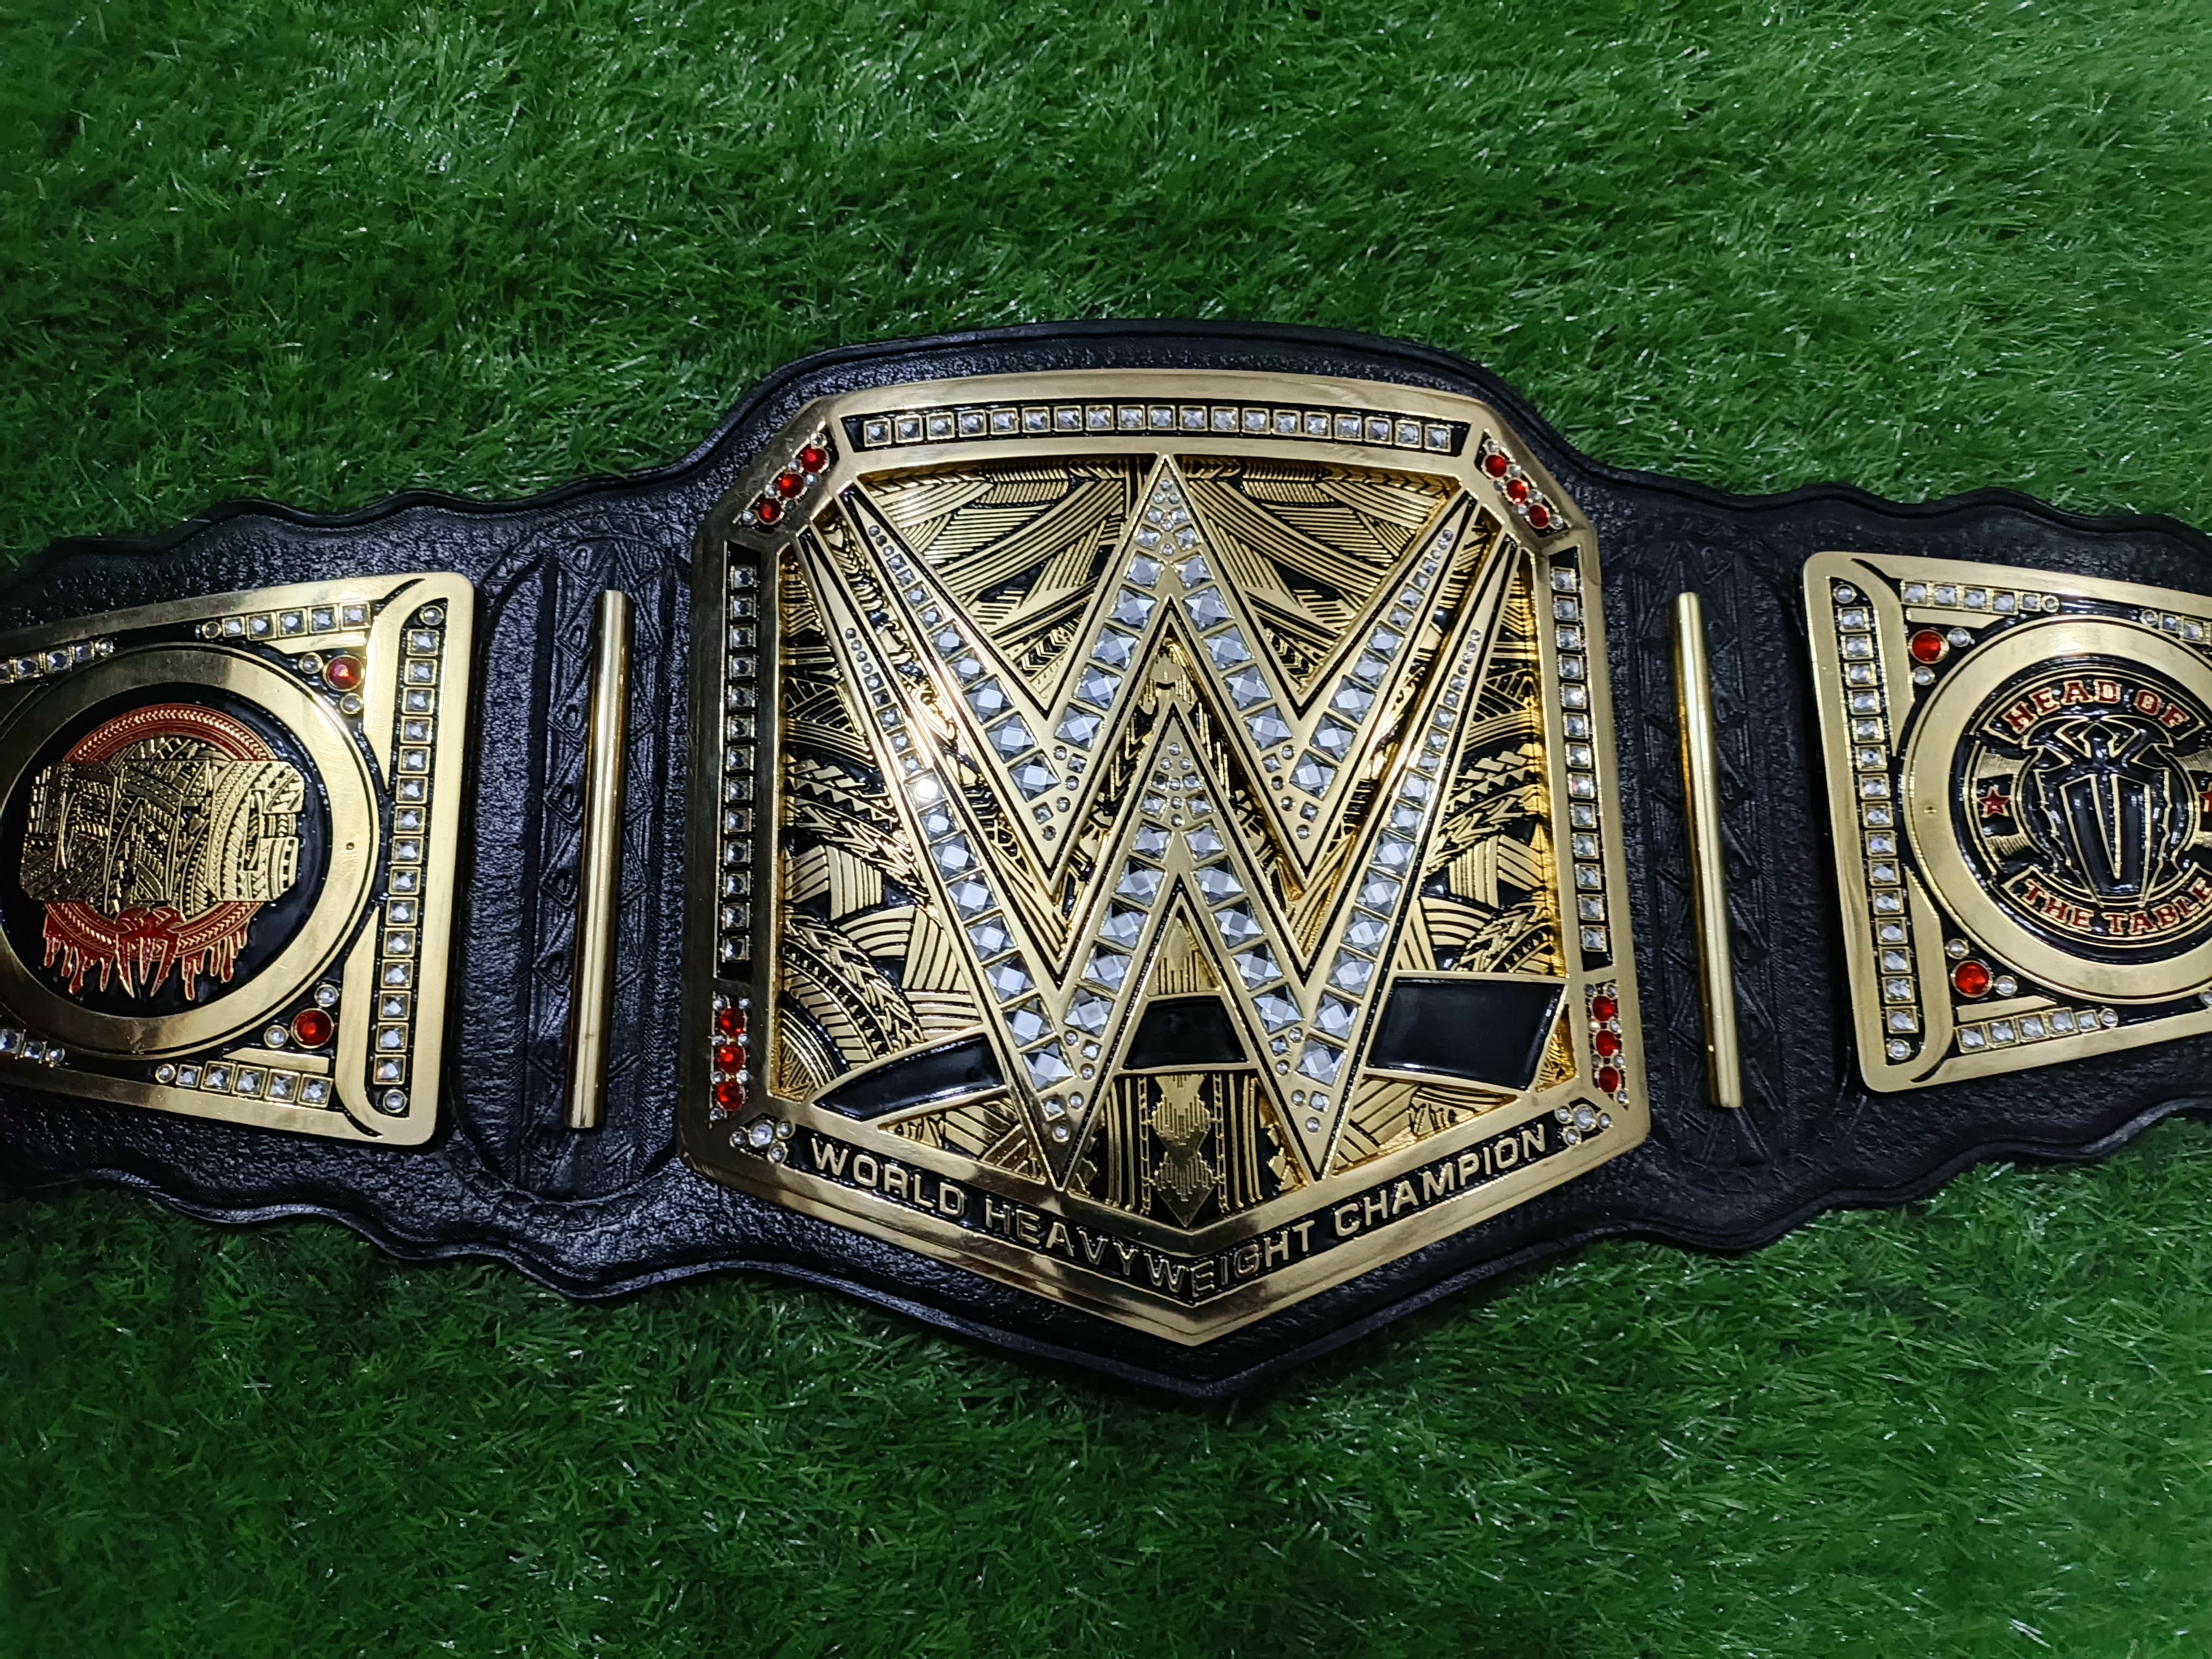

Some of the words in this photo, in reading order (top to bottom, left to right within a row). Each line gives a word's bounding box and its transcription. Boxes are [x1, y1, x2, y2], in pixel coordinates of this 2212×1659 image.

[2002, 679, 2121, 734] HEAD
[2134, 689, 2190, 728] OF
[2021, 877, 2096, 931] THE
[2102, 876, 2212, 936] TABLE
[811, 1138, 966, 1218] WORLD
[985, 1198, 1315, 1297] HEAVYWEIGHT
[1334, 1125, 1546, 1237] CHAMPION
